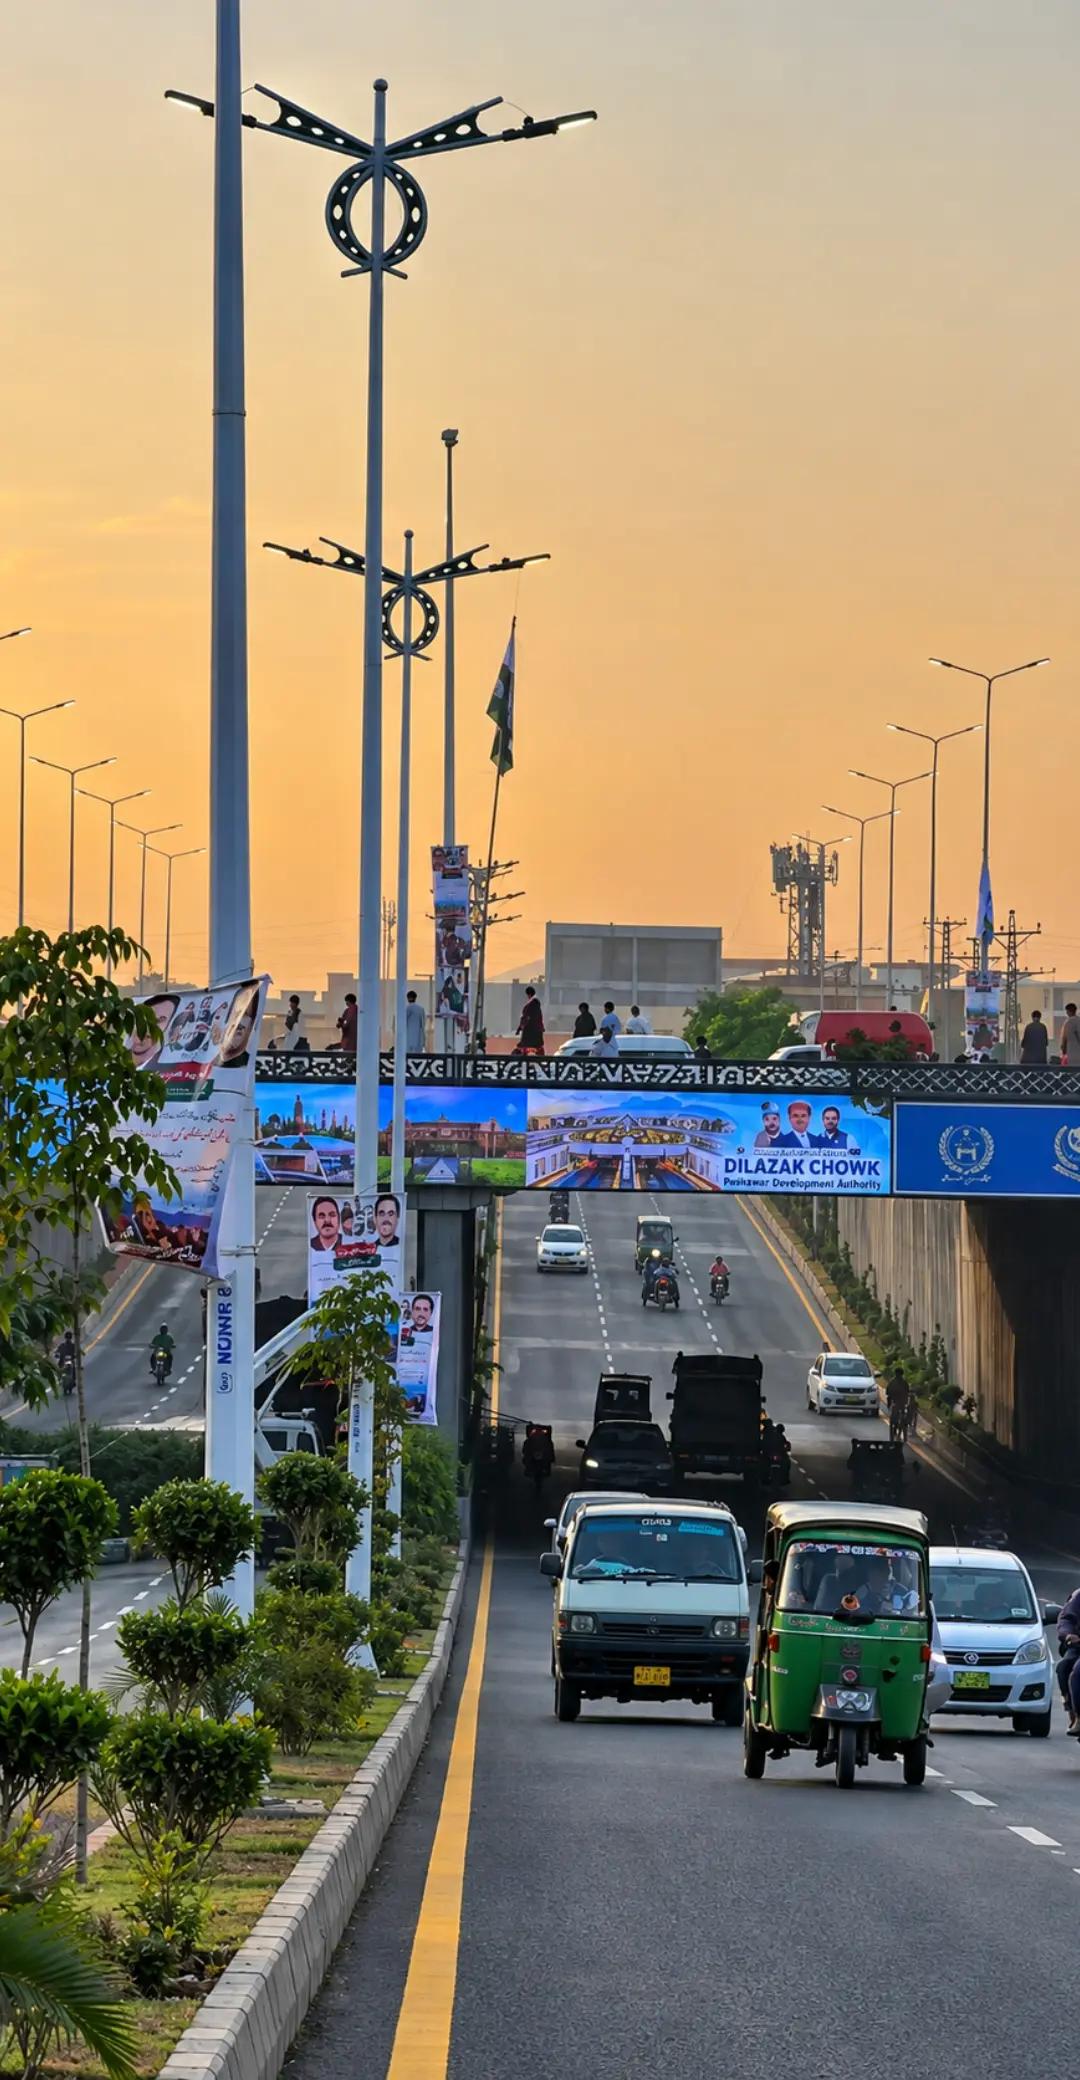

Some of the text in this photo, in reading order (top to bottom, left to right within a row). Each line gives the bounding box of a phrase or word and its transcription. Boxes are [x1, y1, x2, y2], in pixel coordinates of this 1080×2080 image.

[724, 1158, 880, 1176] DILAZAK CHOWK
[772, 1178, 834, 1190] Development
[837, 1180, 881, 1190] Authority
